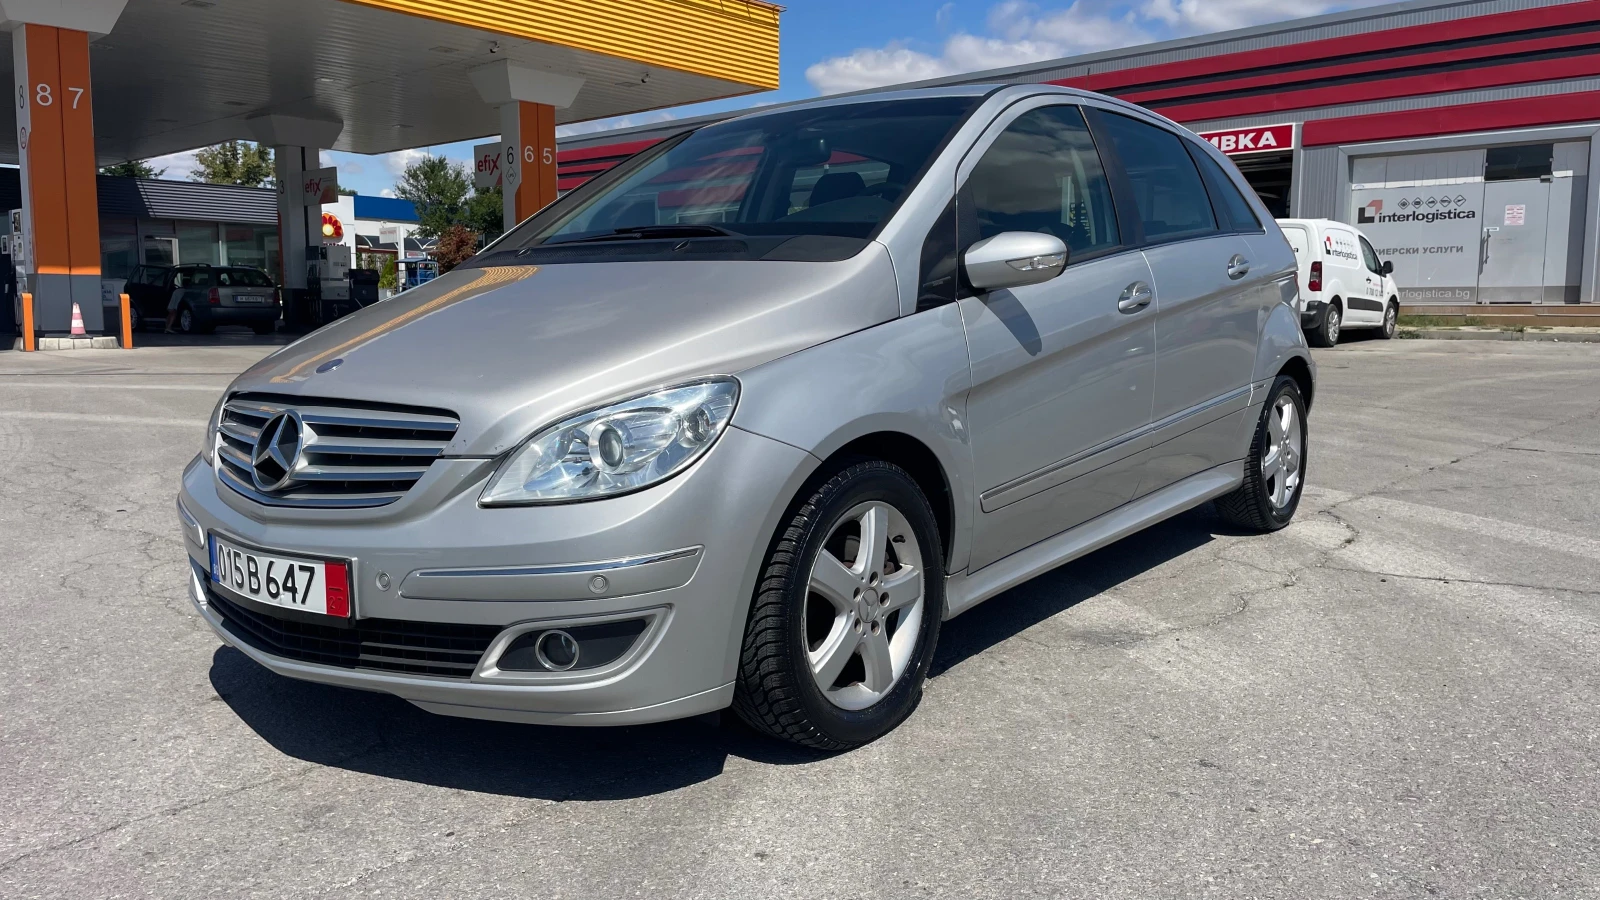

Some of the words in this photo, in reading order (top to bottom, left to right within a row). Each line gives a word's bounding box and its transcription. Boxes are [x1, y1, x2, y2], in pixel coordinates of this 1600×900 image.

[19, 84, 25, 109] 8
[36, 83, 53, 106] 8
[68, 86, 84, 109] 7
[506, 146, 515, 165] 6
[524, 145, 535, 163] 6
[542, 147, 553, 165] 5
[477, 153, 501, 175] efix
[279, 180, 285, 195] 3
[305, 178, 322, 196] efix
[1378, 208, 1476, 223] interlogistica
[1422, 245, 1464, 254] УСЛУГИ
[218, 544, 316, 606] 015B647
